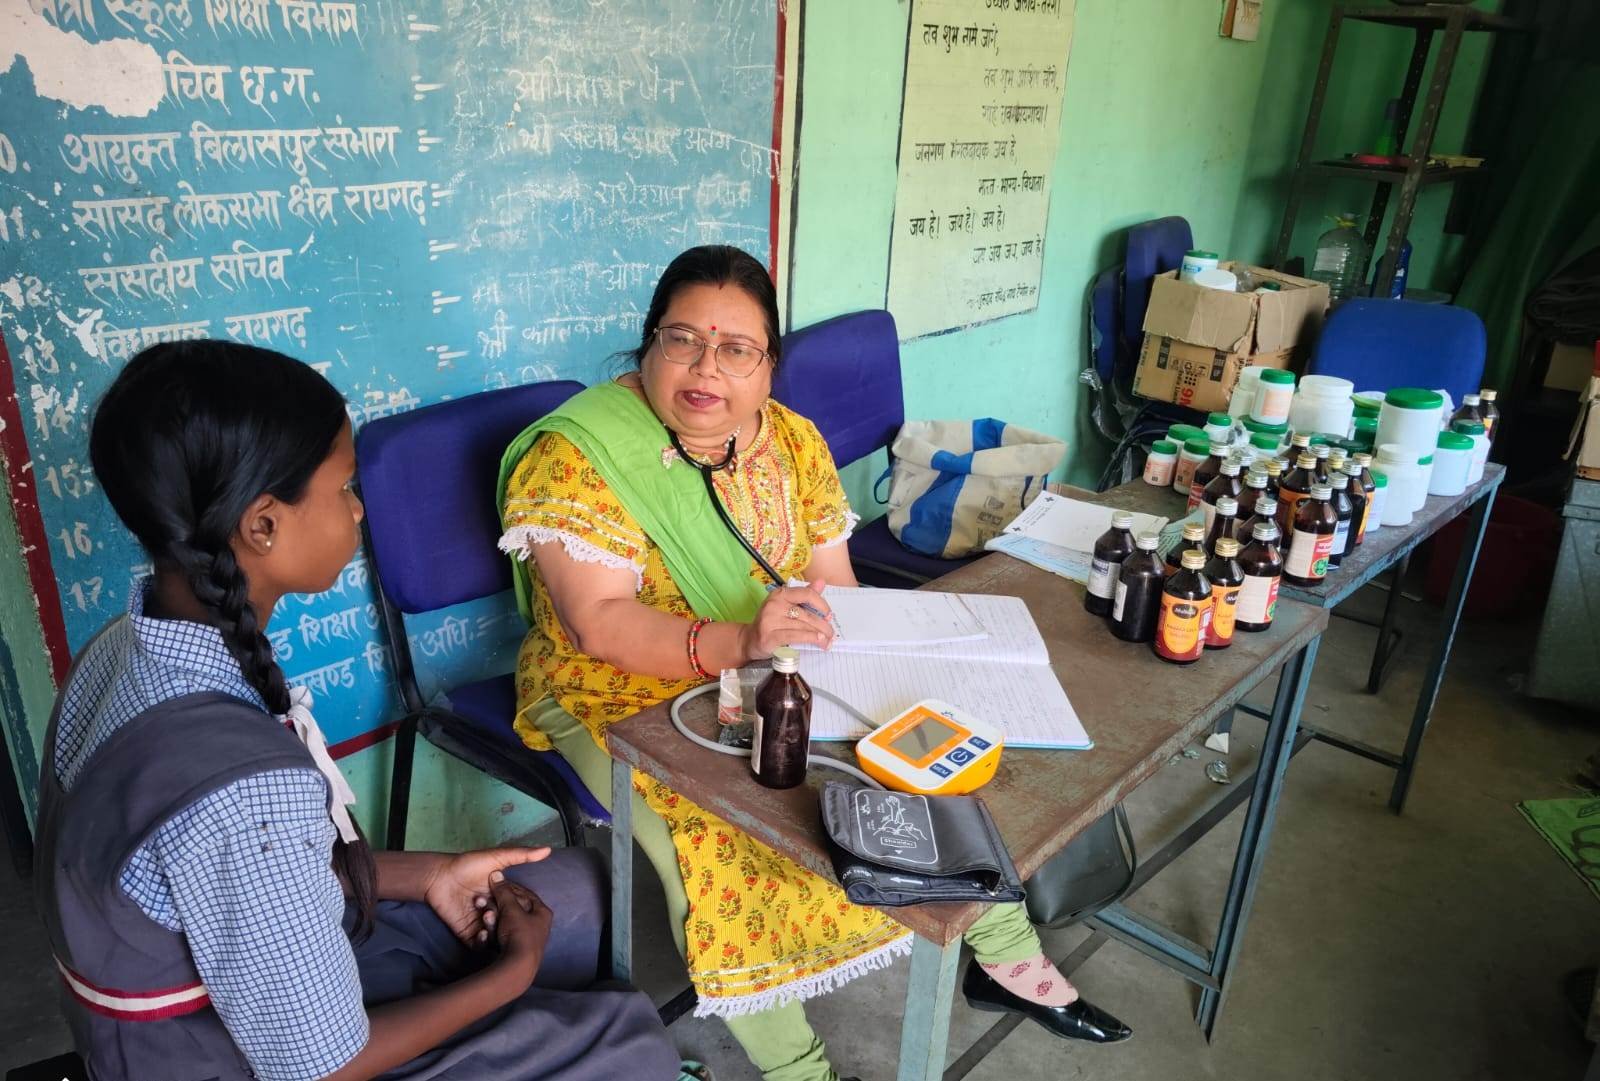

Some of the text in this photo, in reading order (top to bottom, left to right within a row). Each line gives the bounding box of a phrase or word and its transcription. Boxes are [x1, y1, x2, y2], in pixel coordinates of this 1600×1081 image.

[161, 48, 232, 116] चिव
[59, 132, 182, 185] आयुक्त
[189, 120, 327, 179] बिलासपुर
[323, 114, 402, 168] संभाग
[72, 185, 172, 240] सांसद
[172, 180, 286, 235] लोकसभा
[288, 177, 340, 227] क्षेत्र
[909, 217, 927, 238] जय
[210, 240, 294, 298] सचिव
[298, 606, 362, 651] शिक्षा
[284, 656, 355, 698] खण्ड
